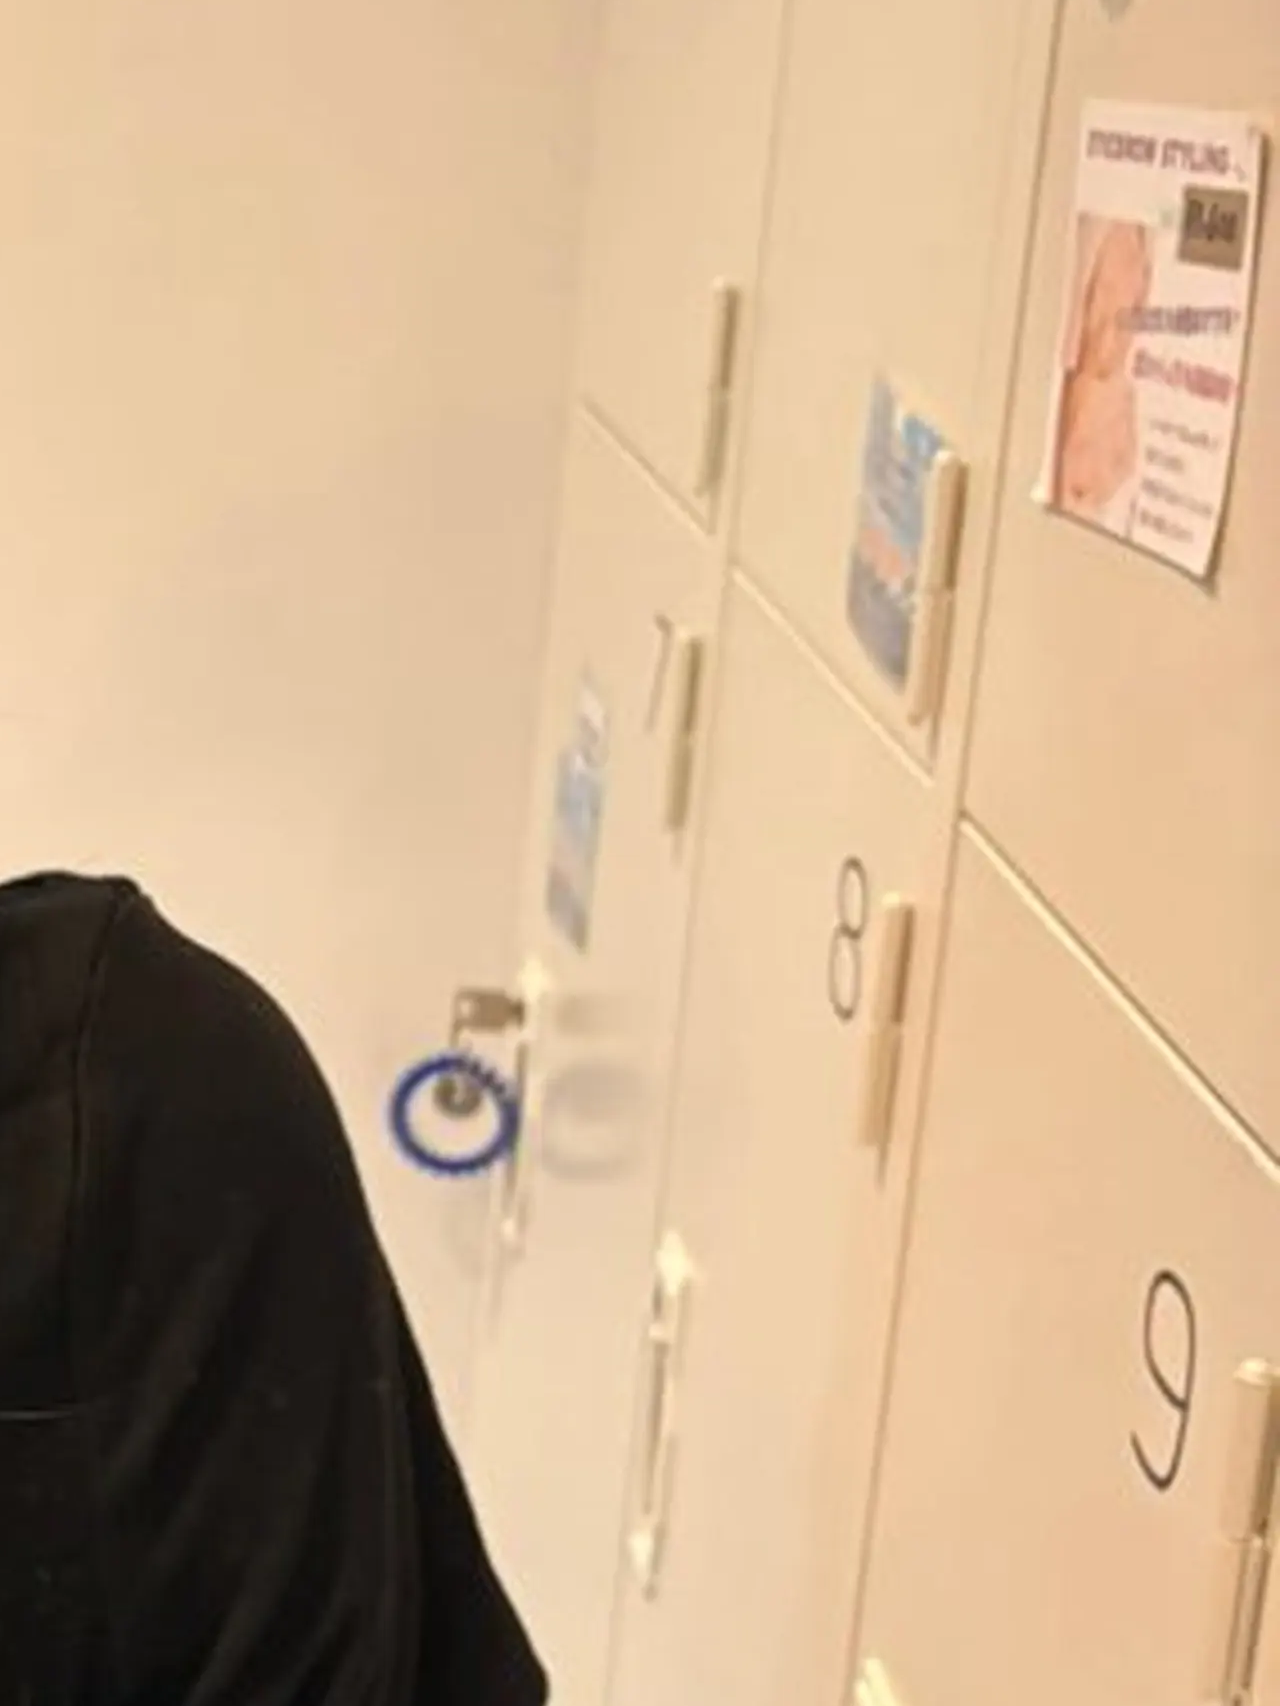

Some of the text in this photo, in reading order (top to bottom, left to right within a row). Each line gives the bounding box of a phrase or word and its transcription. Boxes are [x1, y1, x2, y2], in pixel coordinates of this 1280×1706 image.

[644, 610, 675, 734] 7
[828, 856, 868, 1023] 8
[1130, 1269, 1197, 1491] 9
